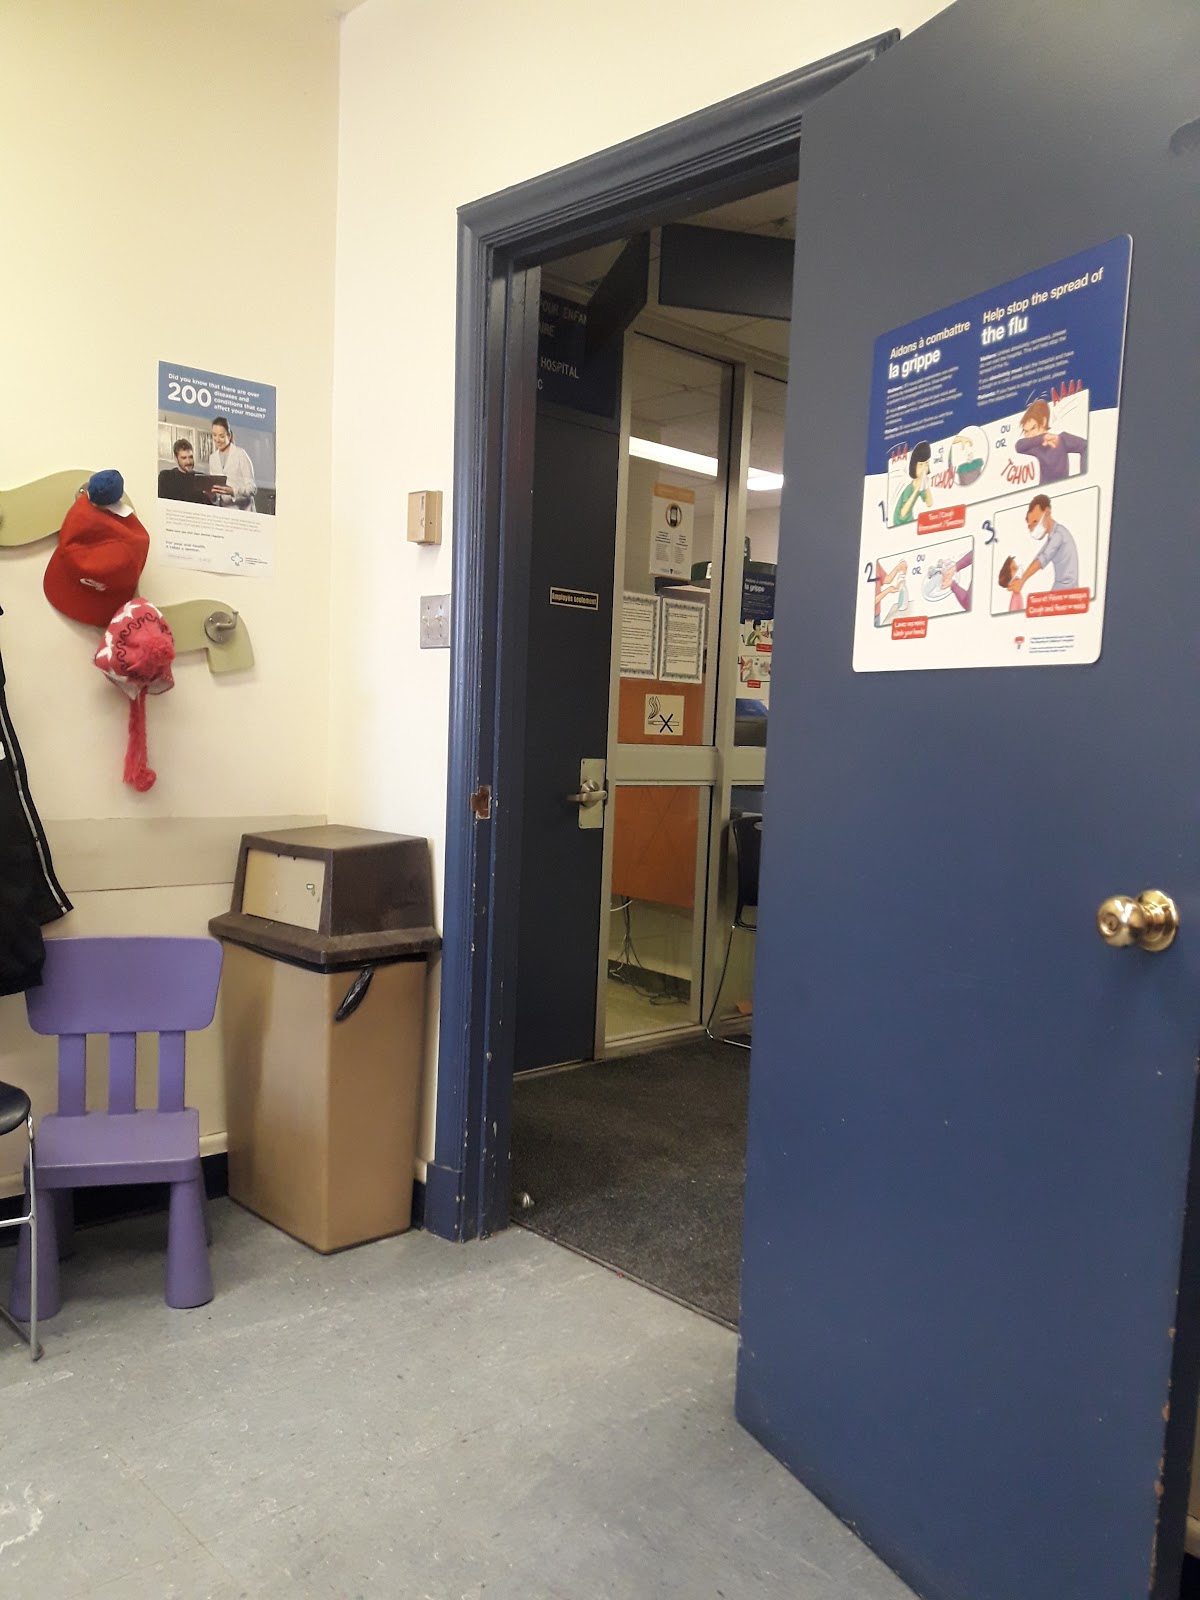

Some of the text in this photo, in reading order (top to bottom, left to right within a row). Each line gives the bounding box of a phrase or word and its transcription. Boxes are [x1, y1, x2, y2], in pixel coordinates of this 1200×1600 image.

[983, 266, 1104, 324] Help stop the spread of
[981, 315, 1028, 345] the flu
[890, 321, 971, 360] Aidons à combattre
[541, 357, 580, 379] HOSPITAL
[888, 349, 941, 379] la grippe
[192, 378, 208, 387] know
[221, 385, 236, 394] there
[167, 382, 212, 408] 200
[214, 390, 237, 400] diseases
[214, 398, 243, 408] conditions
[214, 404, 231, 412] affect
[245, 411, 266, 419] mouth?
[1000, 424, 1011, 434] OU
[995, 438, 1007, 449] OR
[916, 554, 926, 563] OU
[911, 566, 922, 576] OR
[750, 584, 765, 593] grippe
